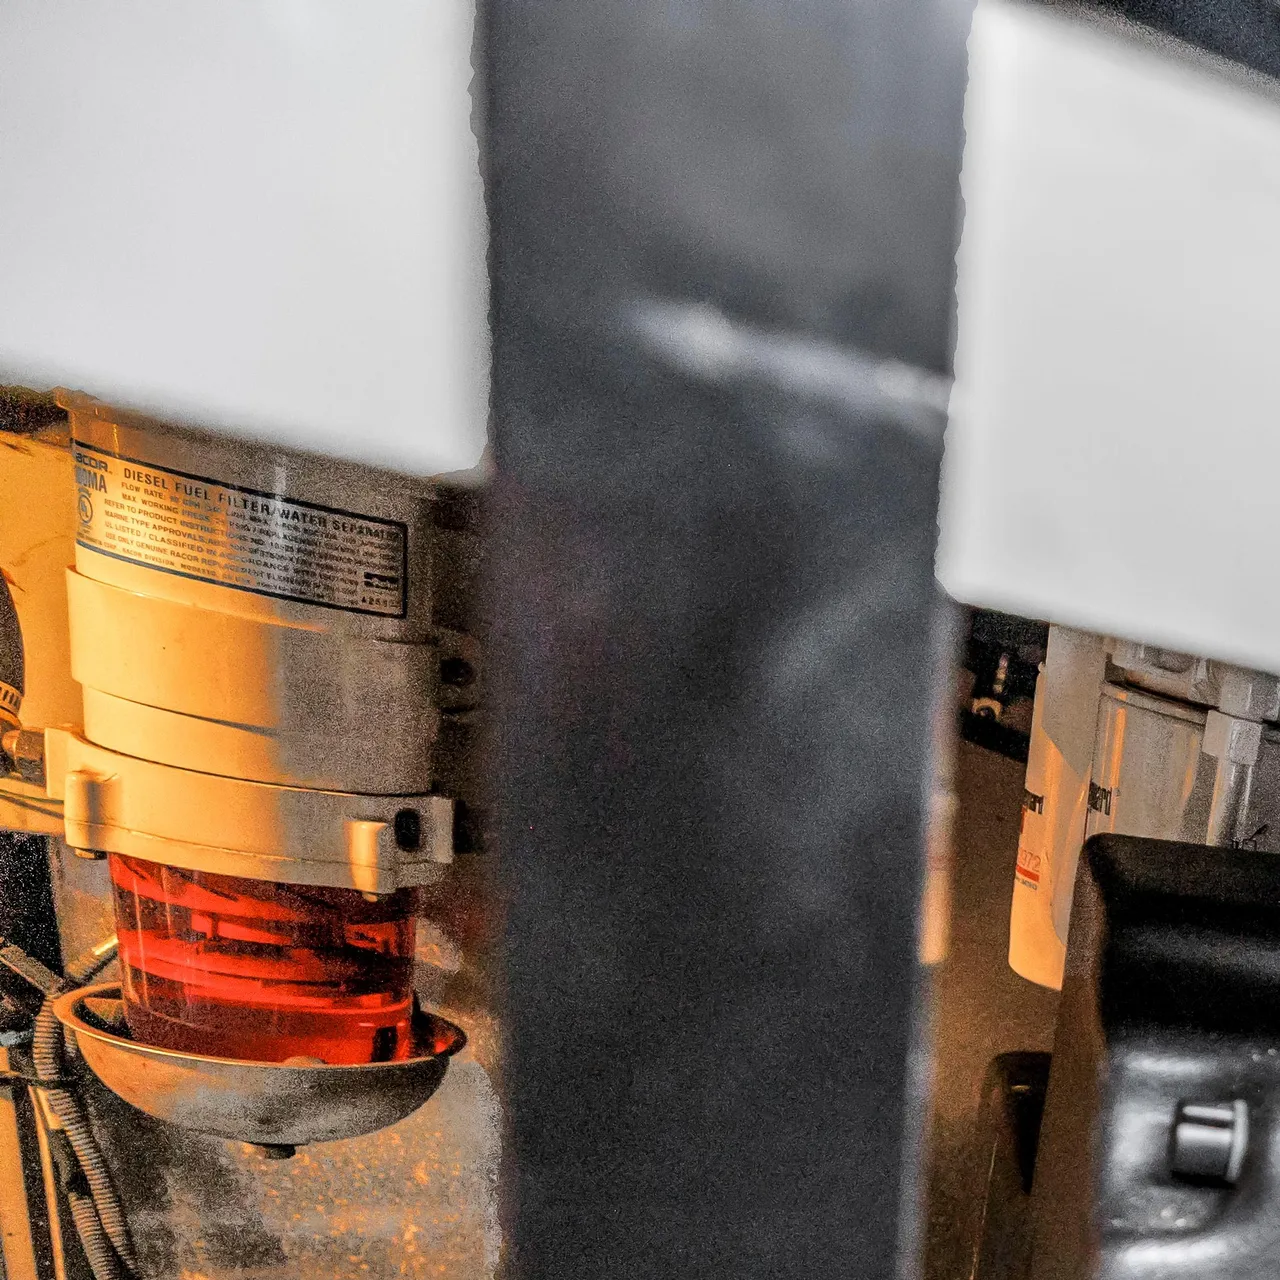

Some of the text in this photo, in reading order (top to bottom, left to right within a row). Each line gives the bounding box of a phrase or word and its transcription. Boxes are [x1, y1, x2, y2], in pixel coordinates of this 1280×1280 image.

[121, 482, 140, 492] FLOW
[124, 467, 168, 490] DIESEL
[175, 482, 211, 501] FUEL
[141, 500, 179, 513] WORKING
[127, 505, 137, 514] TO
[138, 509, 177, 525] PRODUCT
[131, 519, 150, 529] TYPE
[149, 534, 203, 553] CLASSIFIED
[170, 550, 199, 563] RACOR
